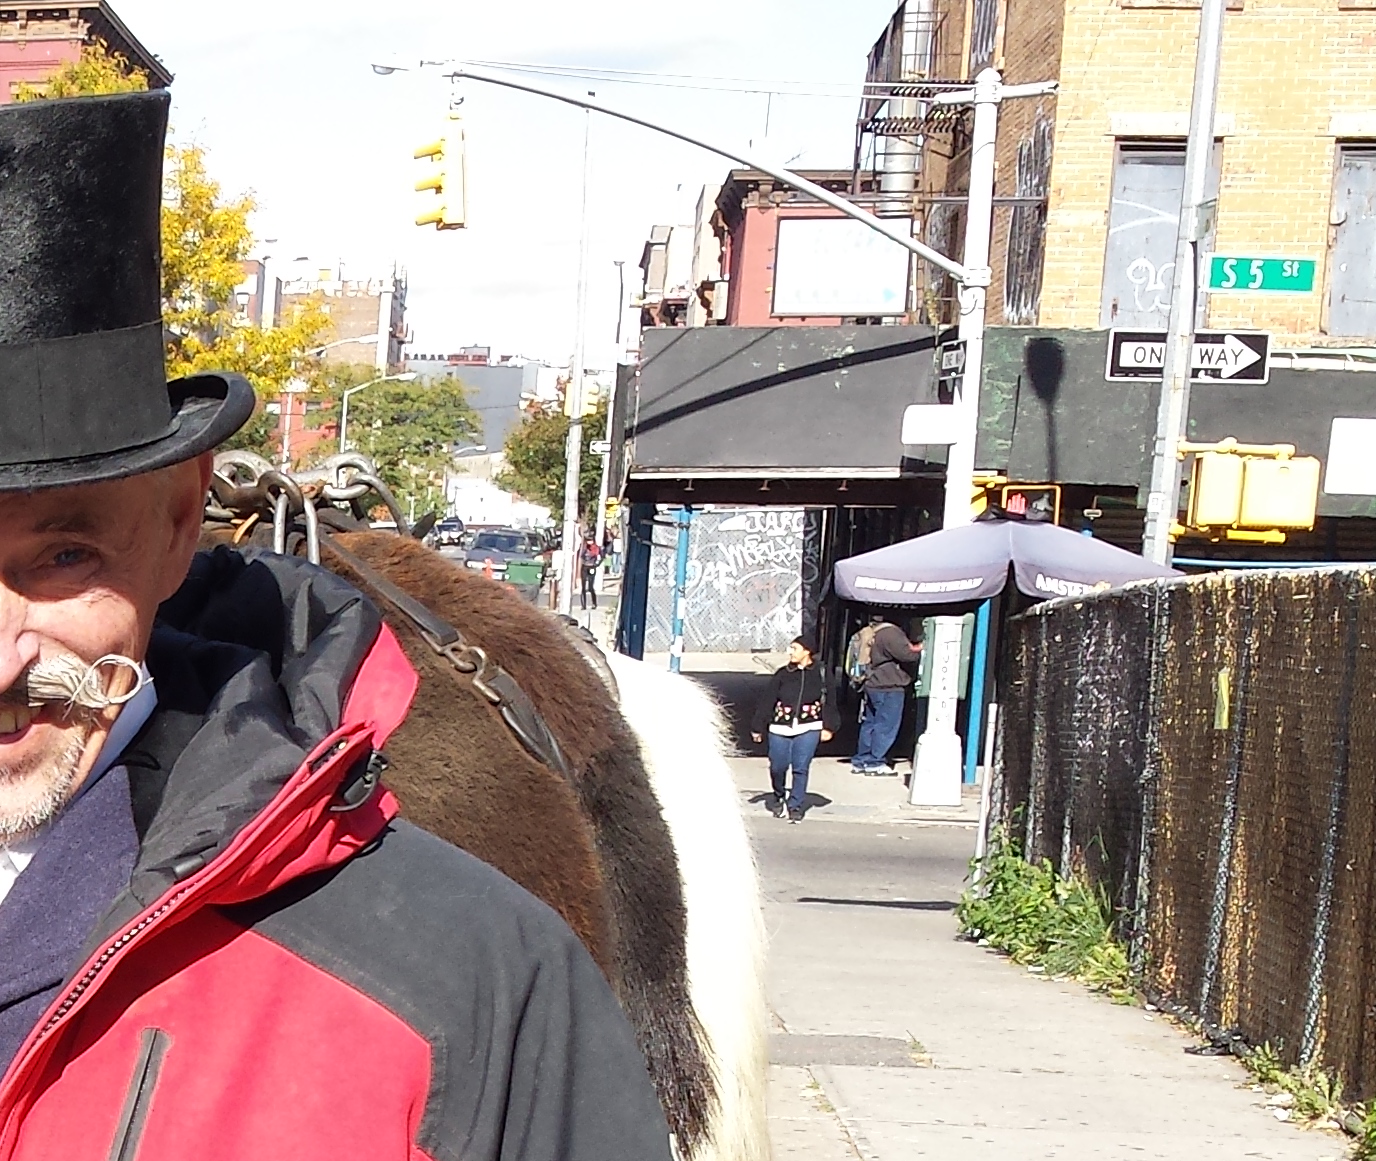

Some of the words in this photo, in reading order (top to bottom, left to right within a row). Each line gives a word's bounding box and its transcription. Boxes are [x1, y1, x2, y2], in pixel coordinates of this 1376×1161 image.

[1221, 258, 1238, 288] S
[1248, 260, 1264, 289] 5
[1282, 260, 1300, 278] St
[1134, 346, 1162, 363] ON
[1199, 347, 1244, 365] WAY
